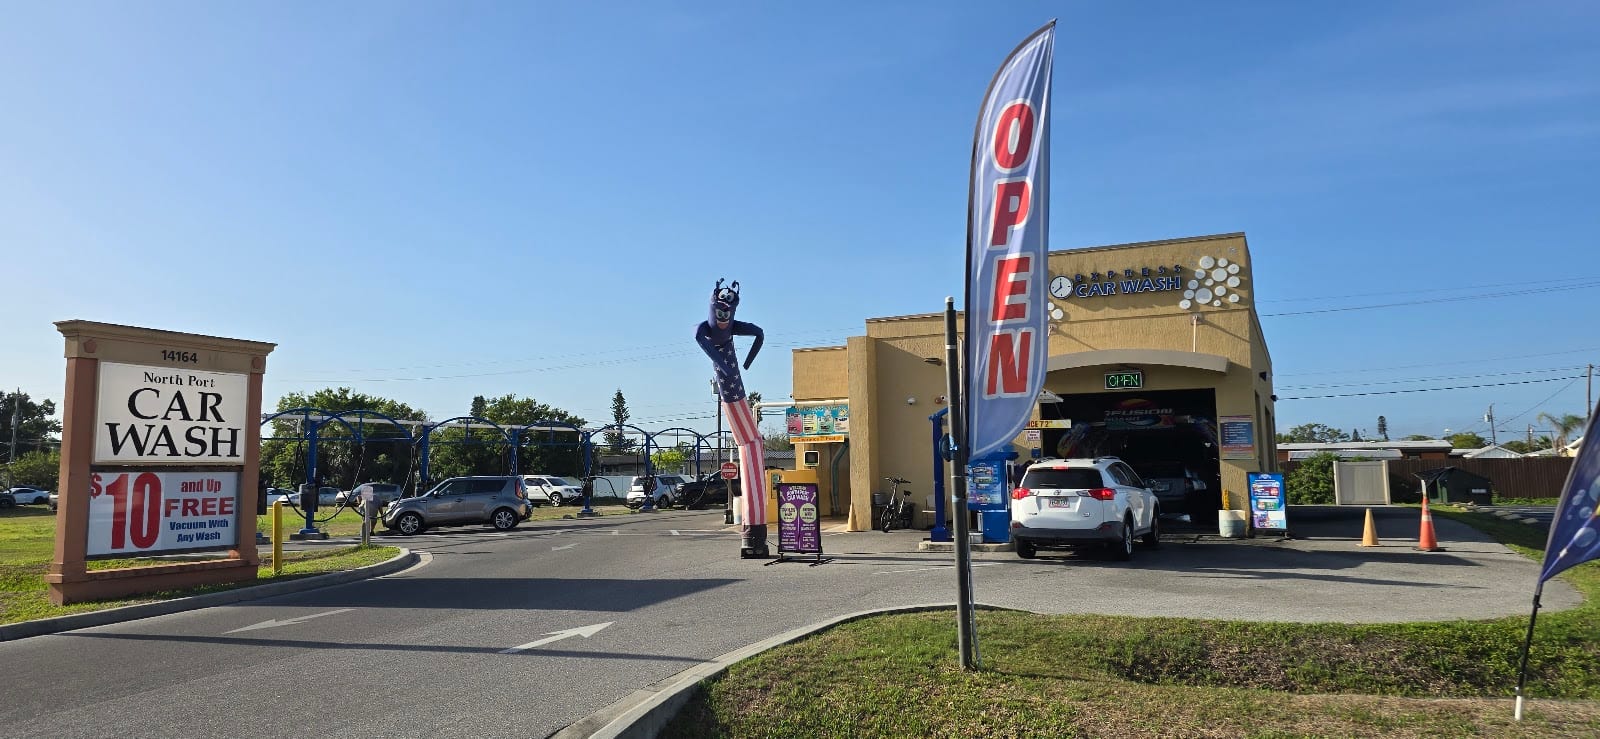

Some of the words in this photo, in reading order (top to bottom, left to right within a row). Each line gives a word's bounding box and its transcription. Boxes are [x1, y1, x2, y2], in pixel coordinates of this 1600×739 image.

[985, 100, 1035, 397] OPEN
[1075, 281, 1116, 297] CAR
[1120, 276, 1181, 293] WASH
[161, 350, 198, 364] 14164
[144, 372, 183, 386] North
[188, 375, 216, 388] Port
[1109, 375, 1138, 387] OPEN
[127, 388, 226, 423] CAR
[105, 422, 241, 458] WASH
[181, 479, 203, 493] and
[206, 478, 221, 494] Up
[164, 497, 235, 518] FREE
[169, 520, 207, 531] Vacuum
[208, 518, 229, 529] With
[176, 533, 194, 543] Any
[196, 531, 221, 542] Wash
